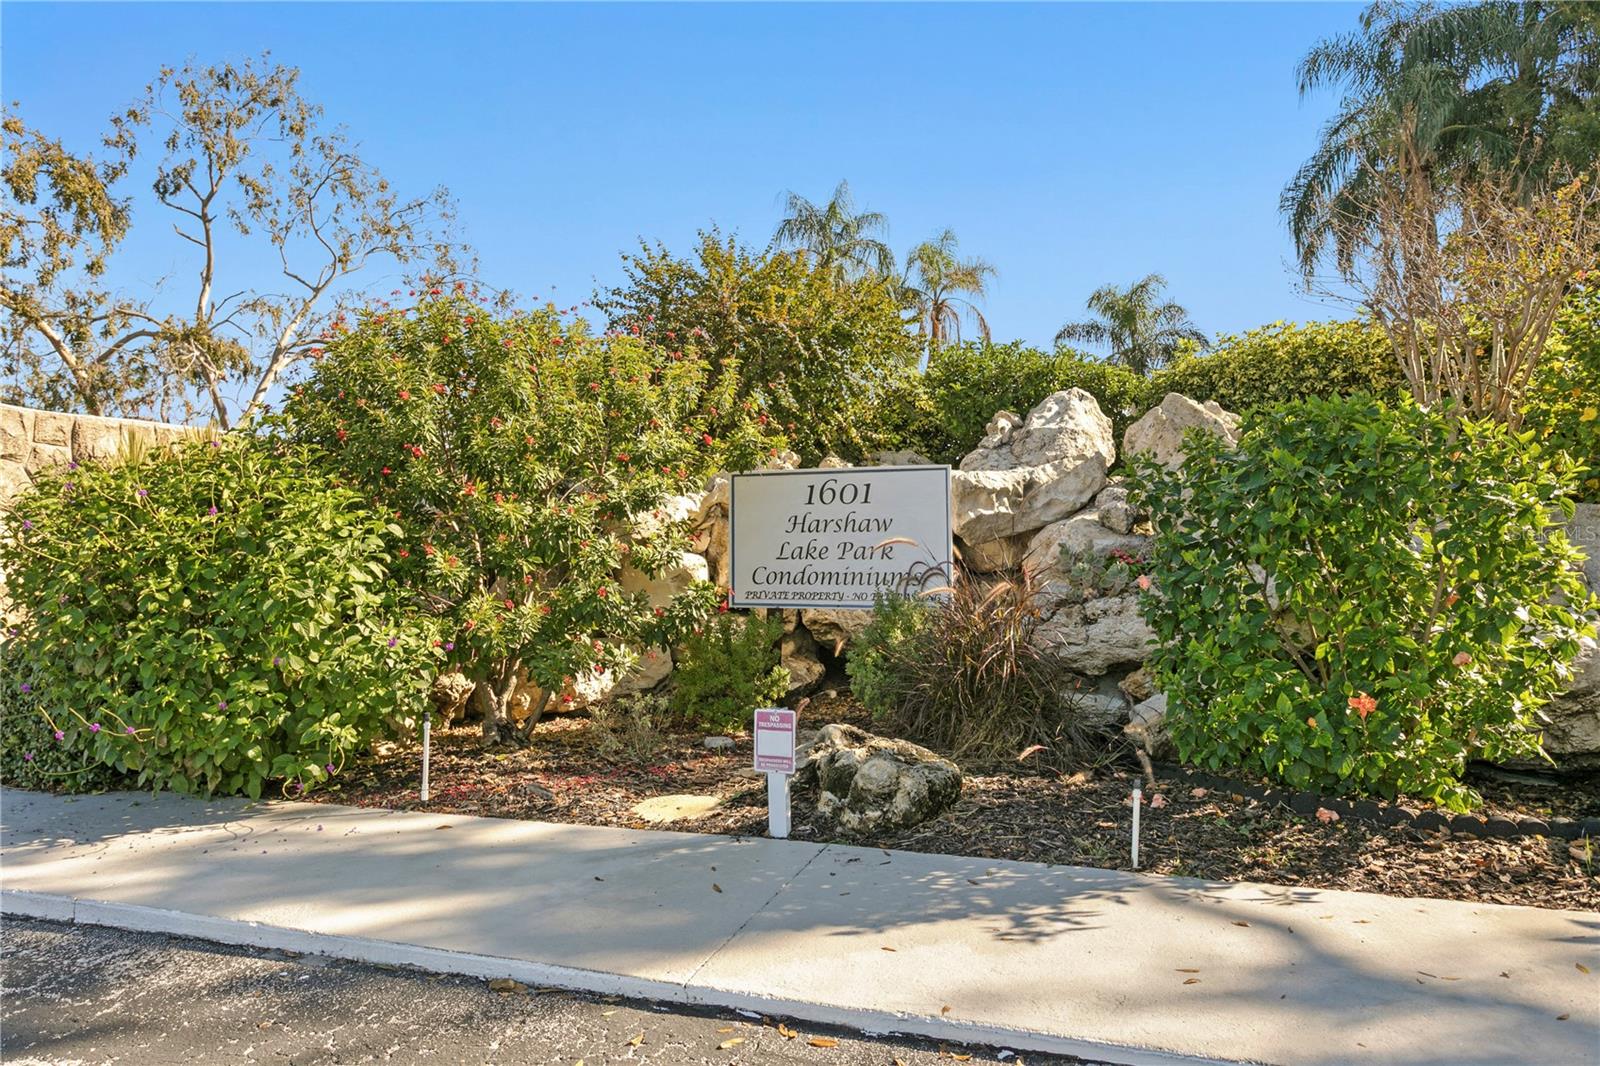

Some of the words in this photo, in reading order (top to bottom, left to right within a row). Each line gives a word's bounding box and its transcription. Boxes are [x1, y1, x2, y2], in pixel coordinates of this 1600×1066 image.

[804, 478, 872, 505] 1601
[784, 511, 894, 534] Harshaw
[775, 538, 829, 560] Lake
[836, 539, 895, 560] Park
[751, 563, 924, 587] Condominiums
[744, 590, 790, 600] PRIVATE
[791, 591, 845, 602] PROPERTY
[852, 592, 868, 601] NO
